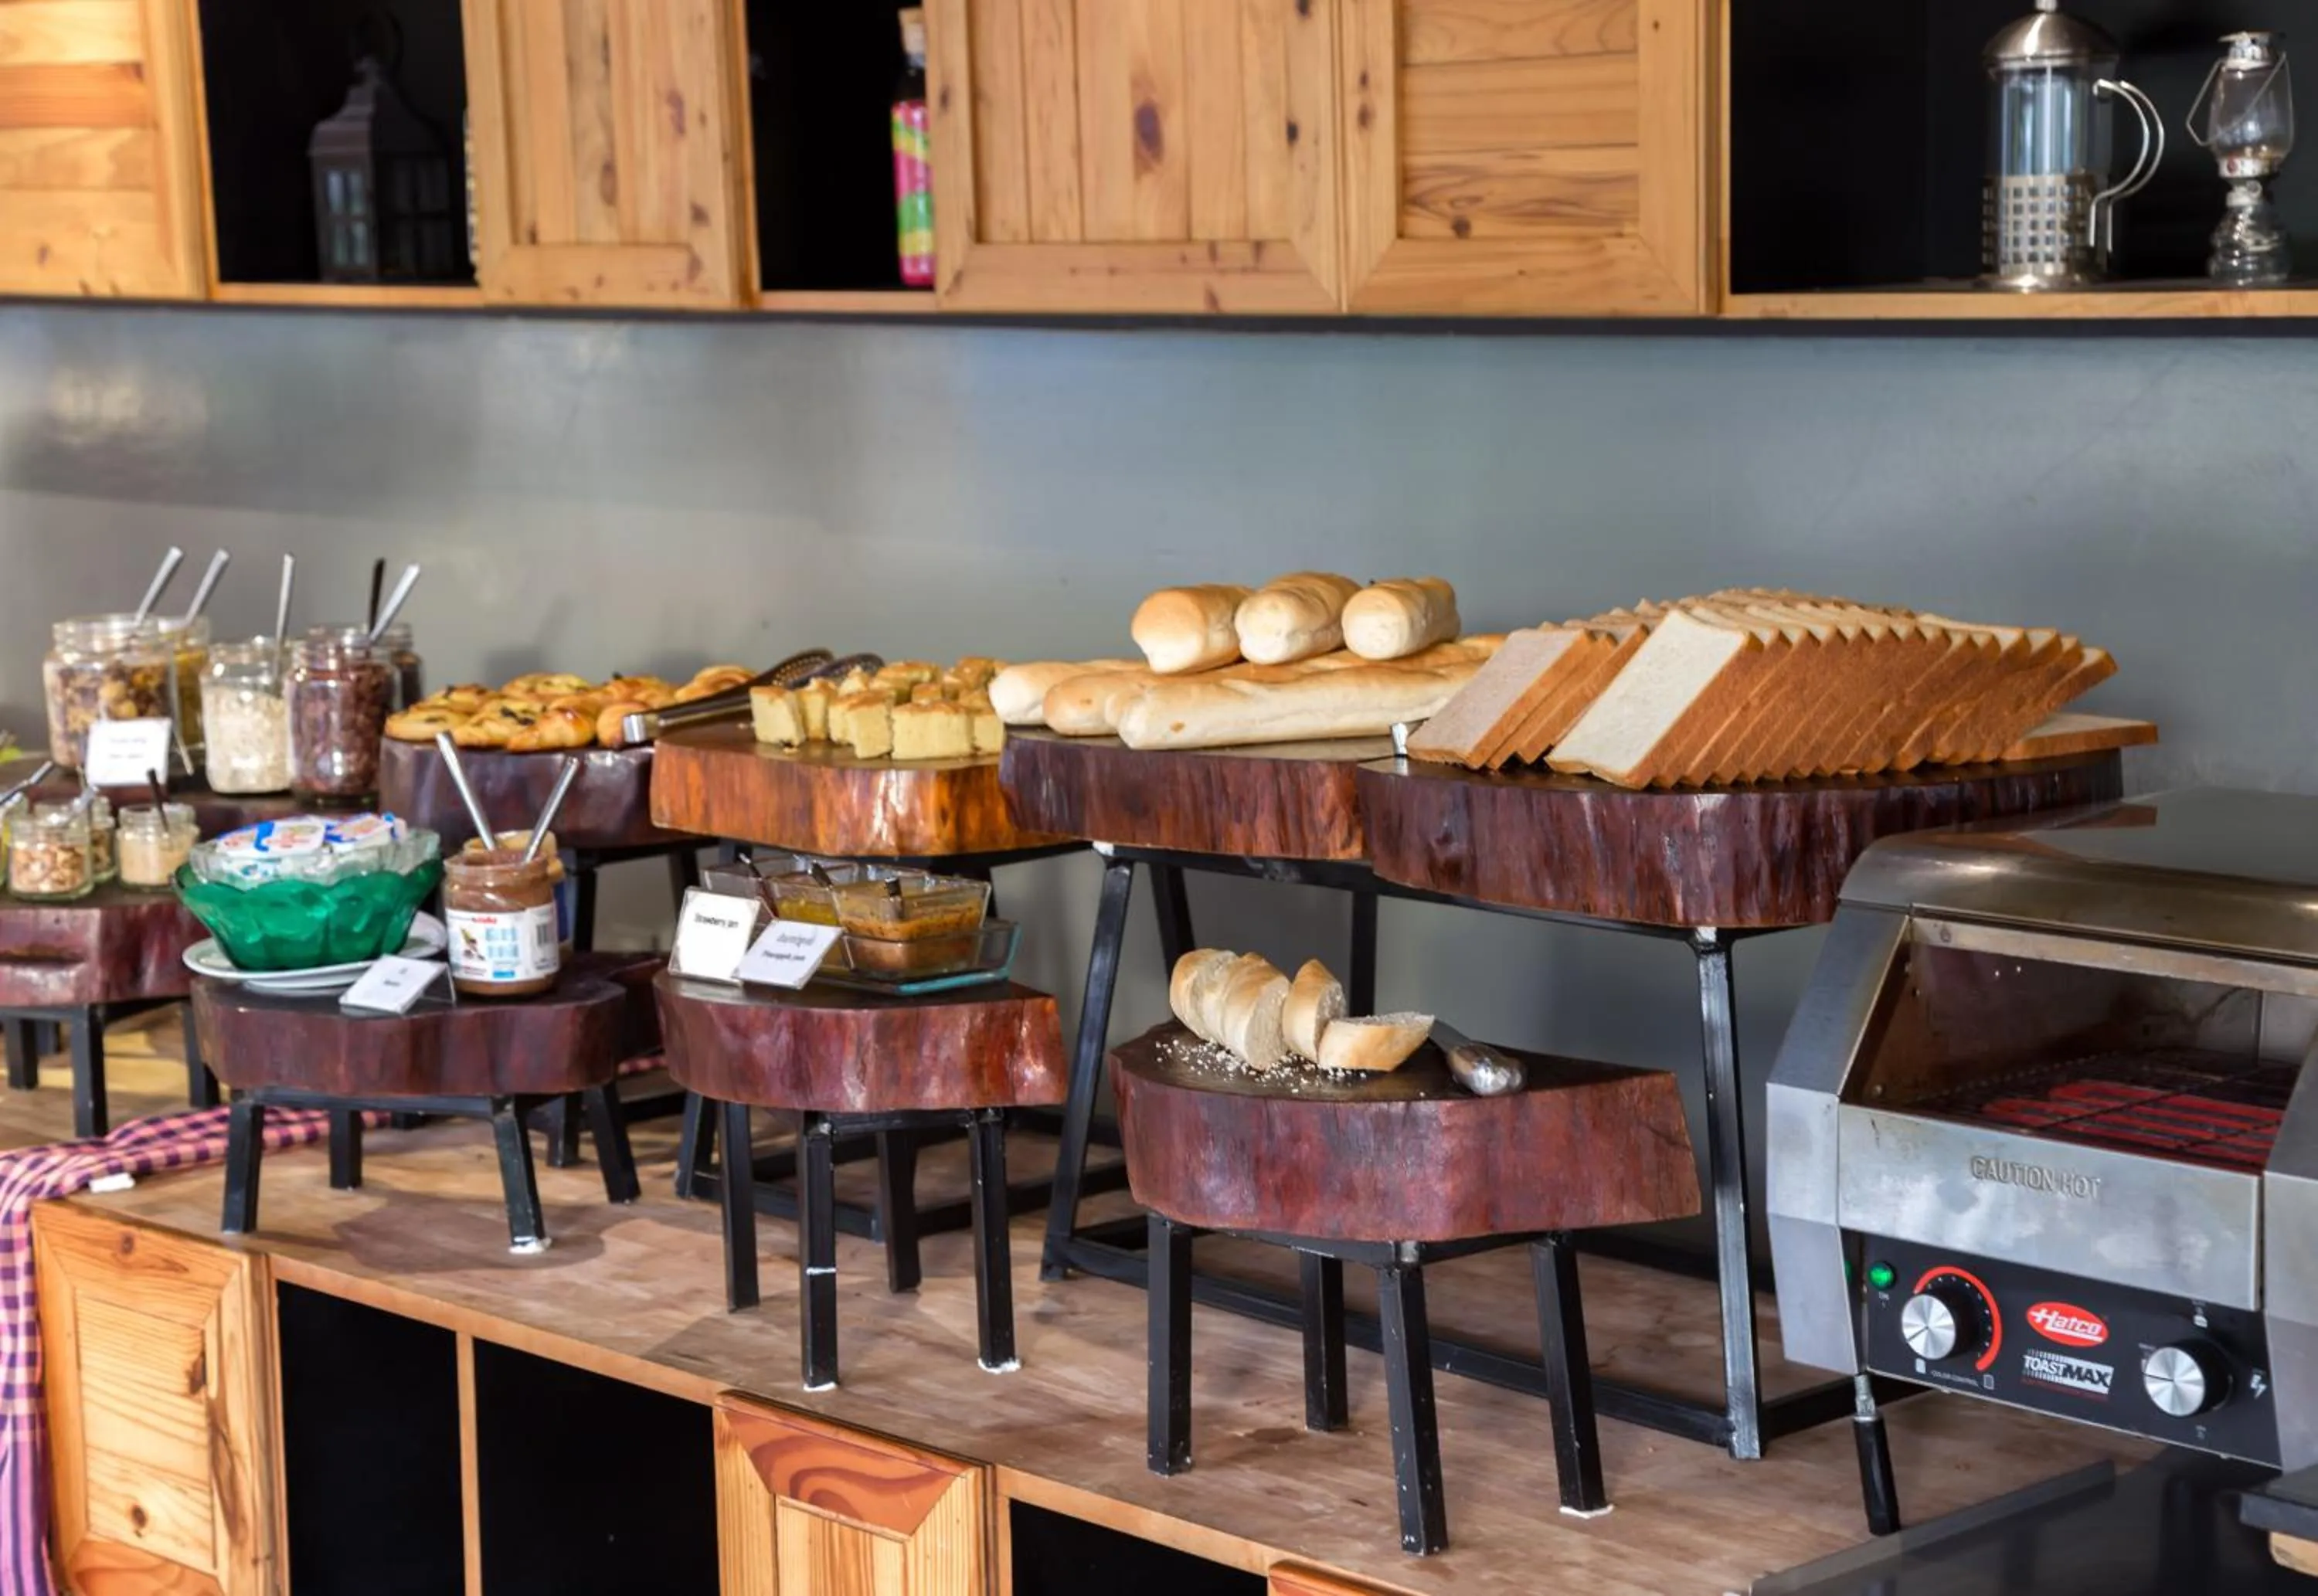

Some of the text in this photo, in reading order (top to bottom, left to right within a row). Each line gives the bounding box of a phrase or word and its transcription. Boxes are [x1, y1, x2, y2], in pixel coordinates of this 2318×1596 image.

[1971, 1156, 2102, 1199] CAUTION HOT
[2028, 1308, 2103, 1343] Hatco
[2023, 1354, 2112, 1388] TOASTMAX
